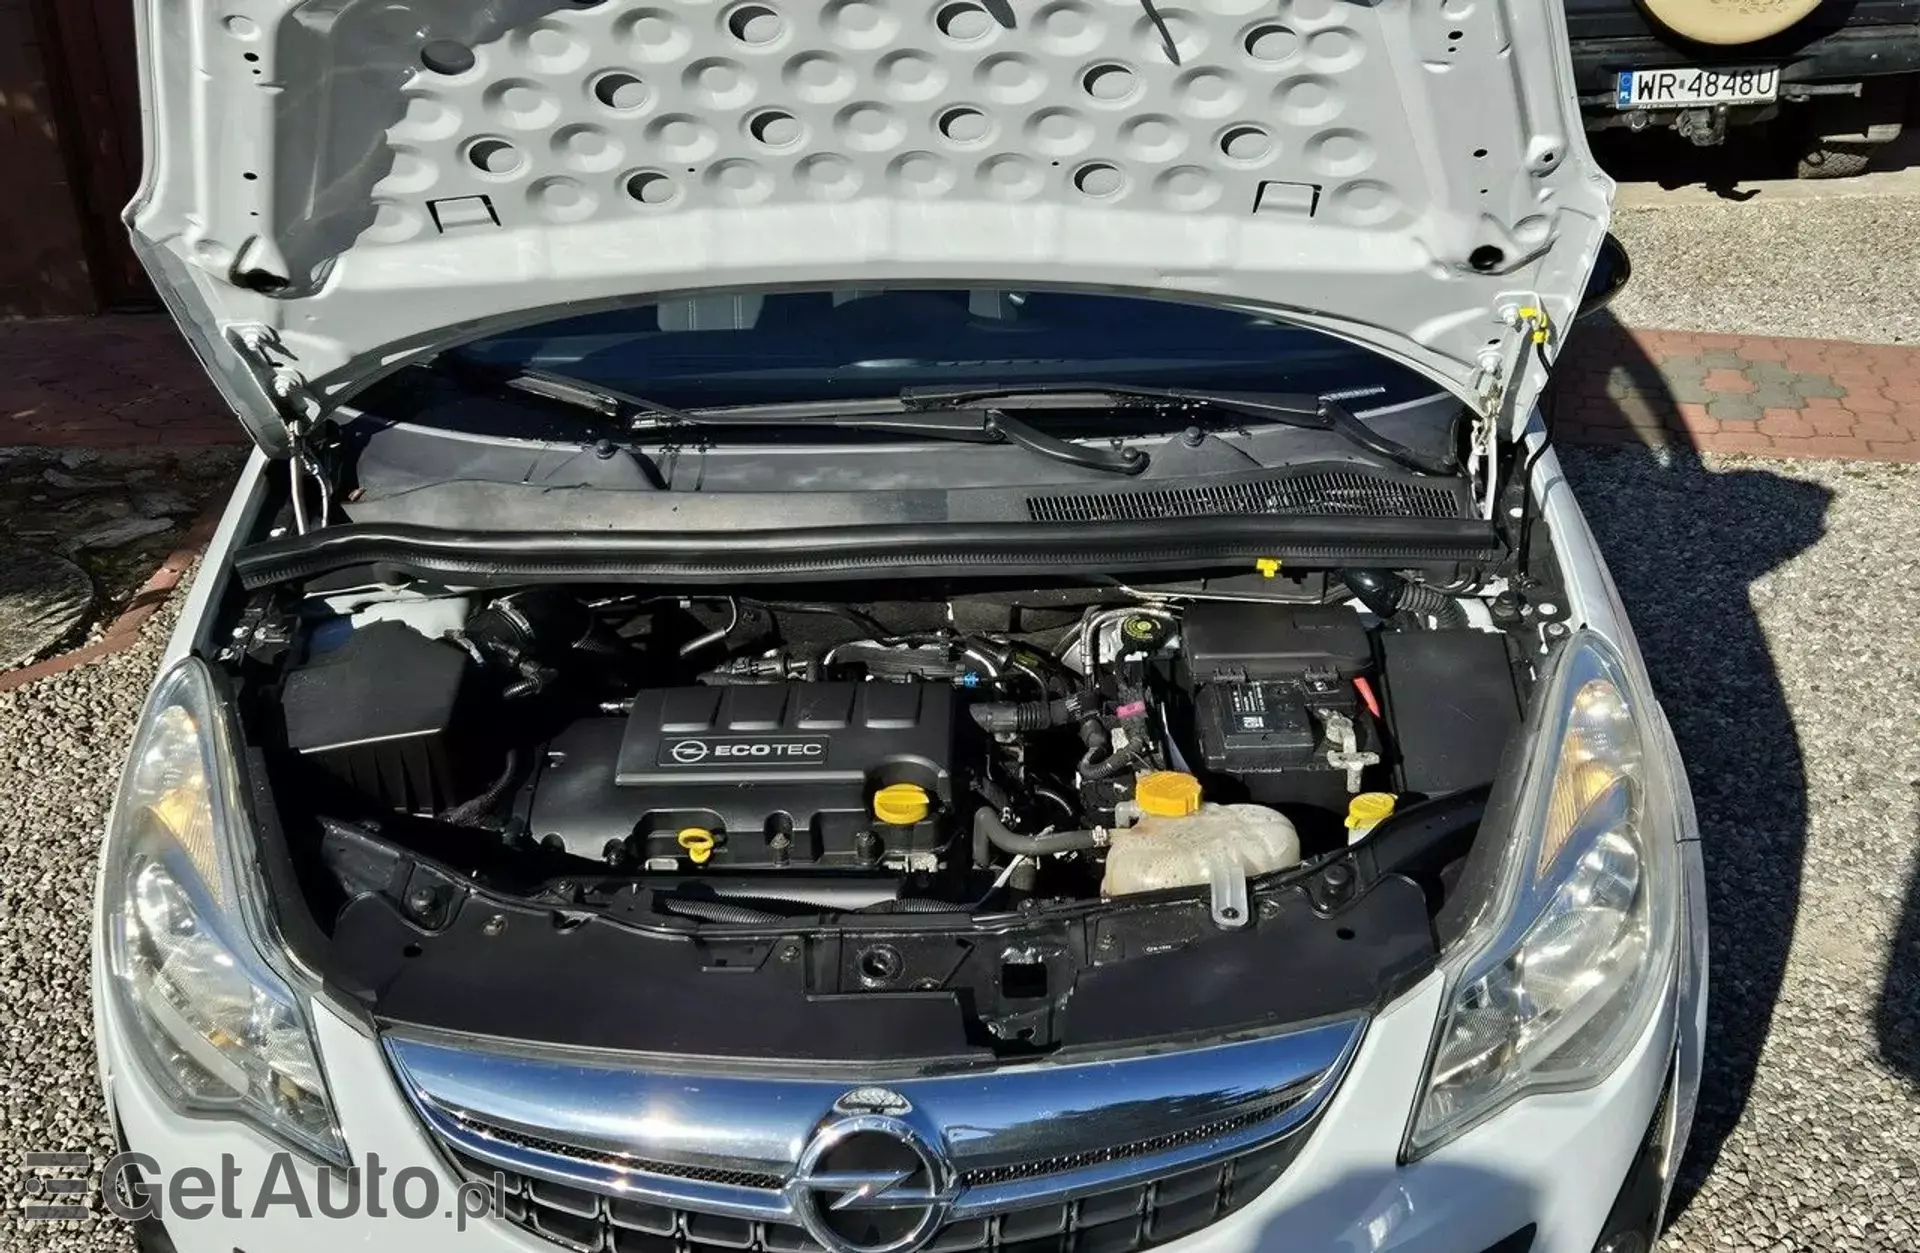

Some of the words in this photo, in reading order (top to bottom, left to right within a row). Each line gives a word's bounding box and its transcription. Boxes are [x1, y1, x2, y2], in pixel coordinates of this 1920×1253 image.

[1637, 73, 1677, 100] WR
[1687, 69, 1774, 98] 4848U
[714, 743, 822, 756] ECOTEC
